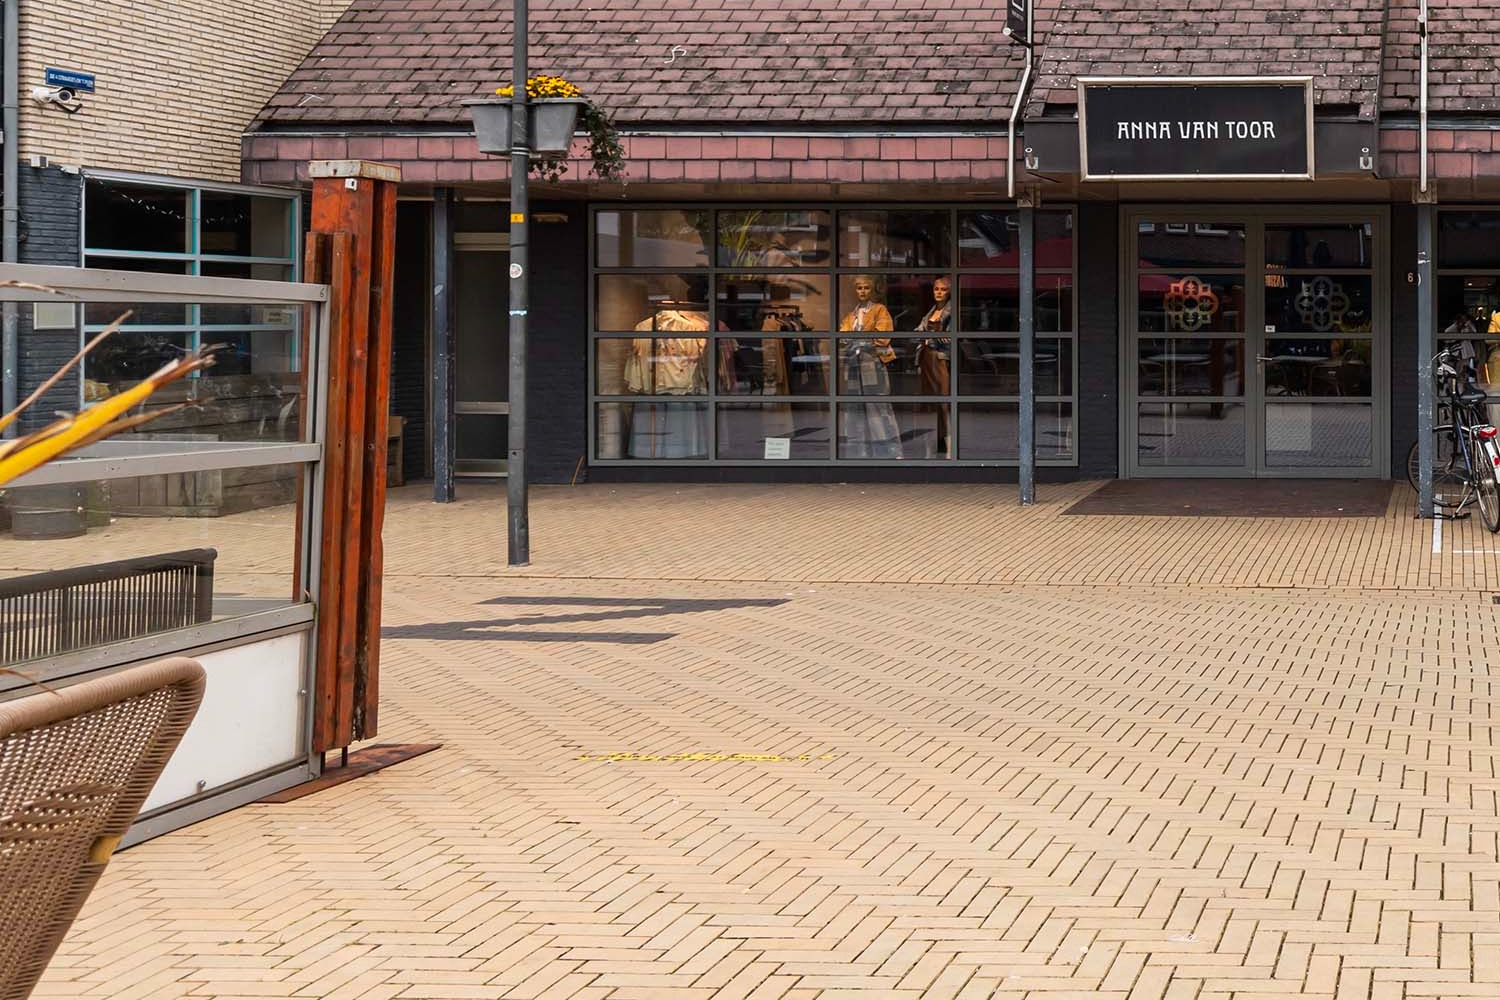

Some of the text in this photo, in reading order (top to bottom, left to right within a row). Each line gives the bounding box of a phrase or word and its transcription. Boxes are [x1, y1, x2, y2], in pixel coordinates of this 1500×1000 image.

[1117, 121, 1276, 139] ANNA VAN TOOR
